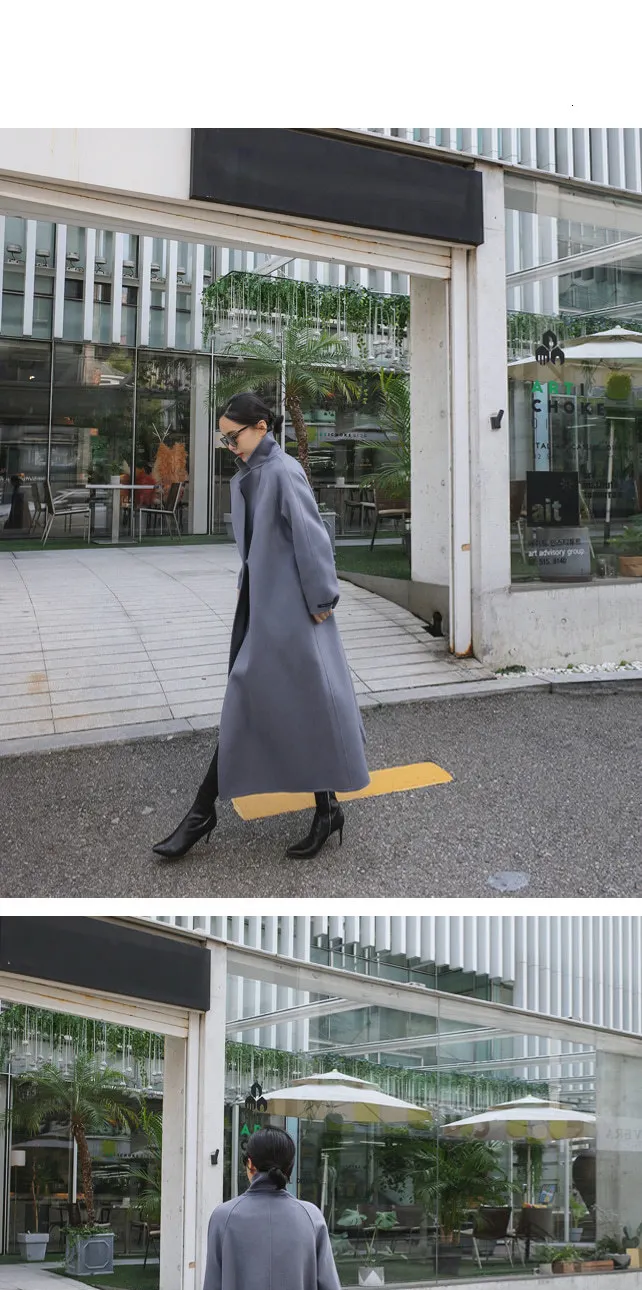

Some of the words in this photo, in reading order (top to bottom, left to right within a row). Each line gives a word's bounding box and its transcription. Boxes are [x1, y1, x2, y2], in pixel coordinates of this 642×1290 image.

[531, 399, 605, 416] CHOKE
[532, 498, 562, 523] ait
[538, 548, 566, 557] advisory
[566, 547, 585, 557] group
